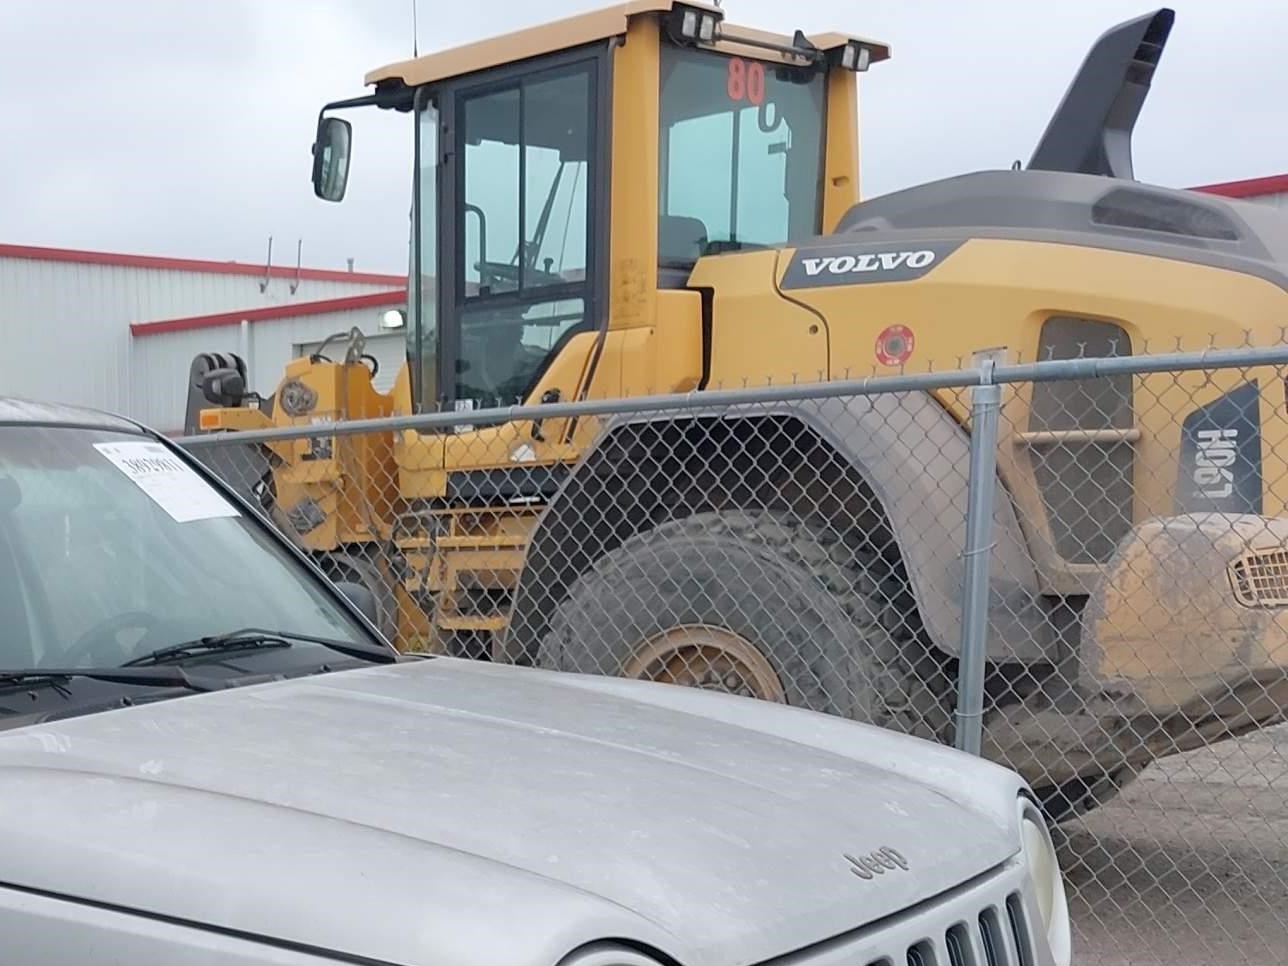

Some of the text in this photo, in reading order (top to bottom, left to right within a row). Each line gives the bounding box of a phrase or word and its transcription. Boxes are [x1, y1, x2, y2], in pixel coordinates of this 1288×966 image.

[728, 57, 764, 105] 80
[802, 250, 936, 275] VOLVO
[842, 846, 909, 880] Jeep
